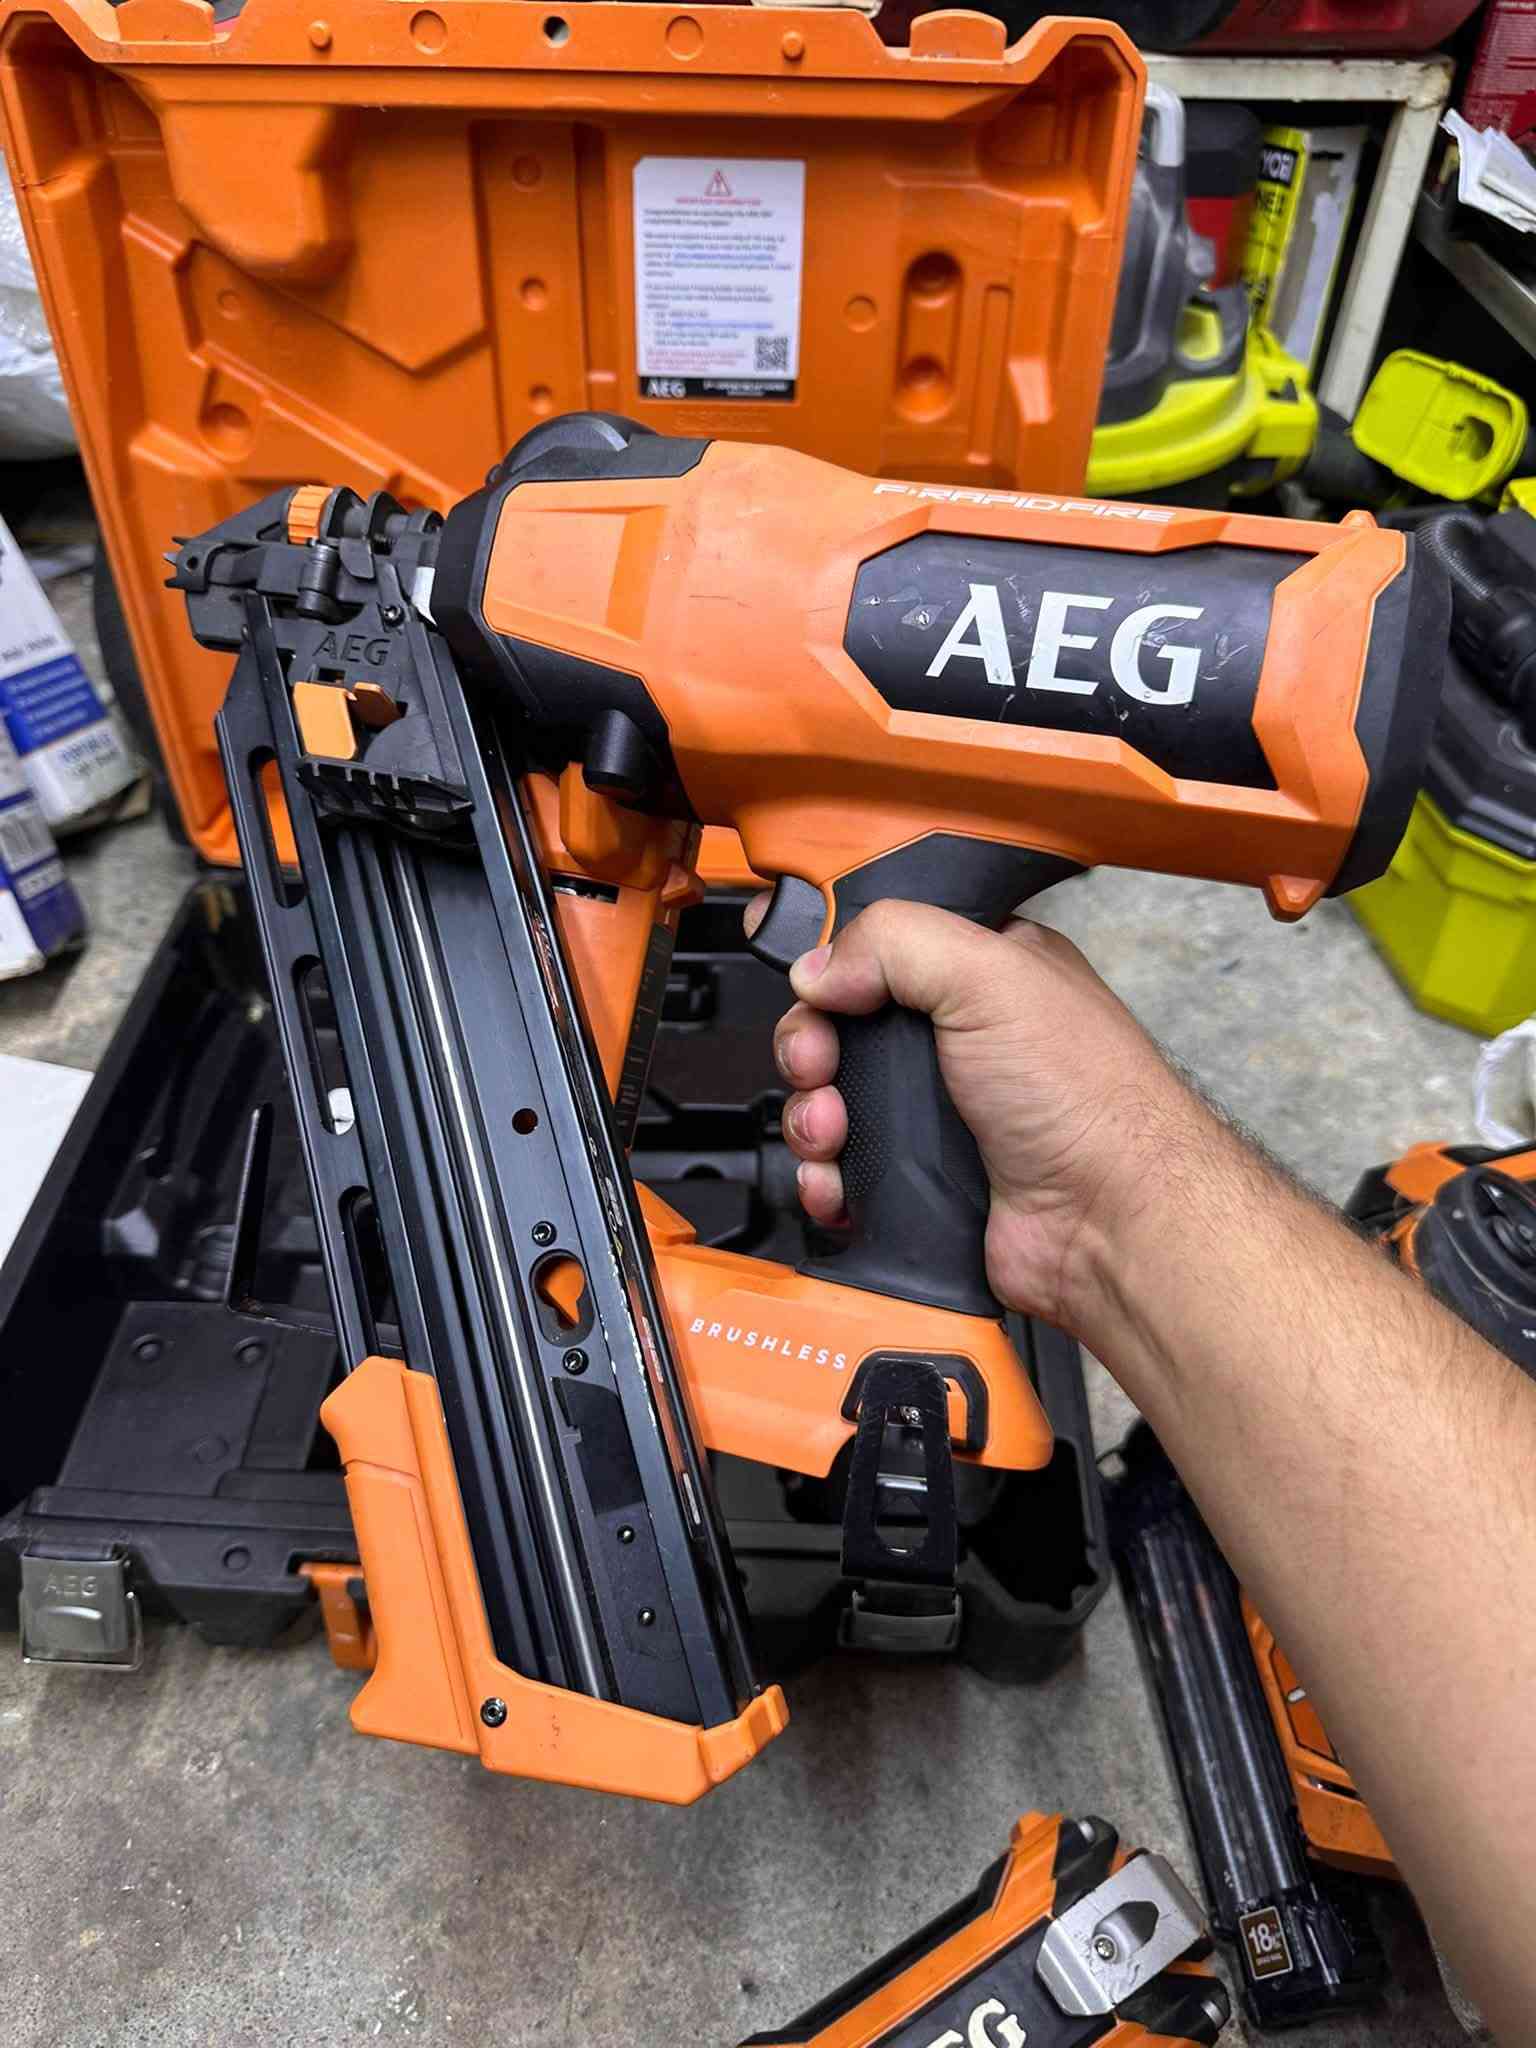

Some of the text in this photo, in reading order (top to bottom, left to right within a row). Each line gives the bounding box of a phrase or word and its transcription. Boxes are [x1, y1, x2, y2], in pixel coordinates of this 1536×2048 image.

[646, 379, 687, 398] AEG
[312, 631, 391, 666] AEG
[925, 583, 1205, 705] AEG
[689, 1318, 847, 1370] BRUSHLESS
[43, 1573, 97, 1597] AEG
